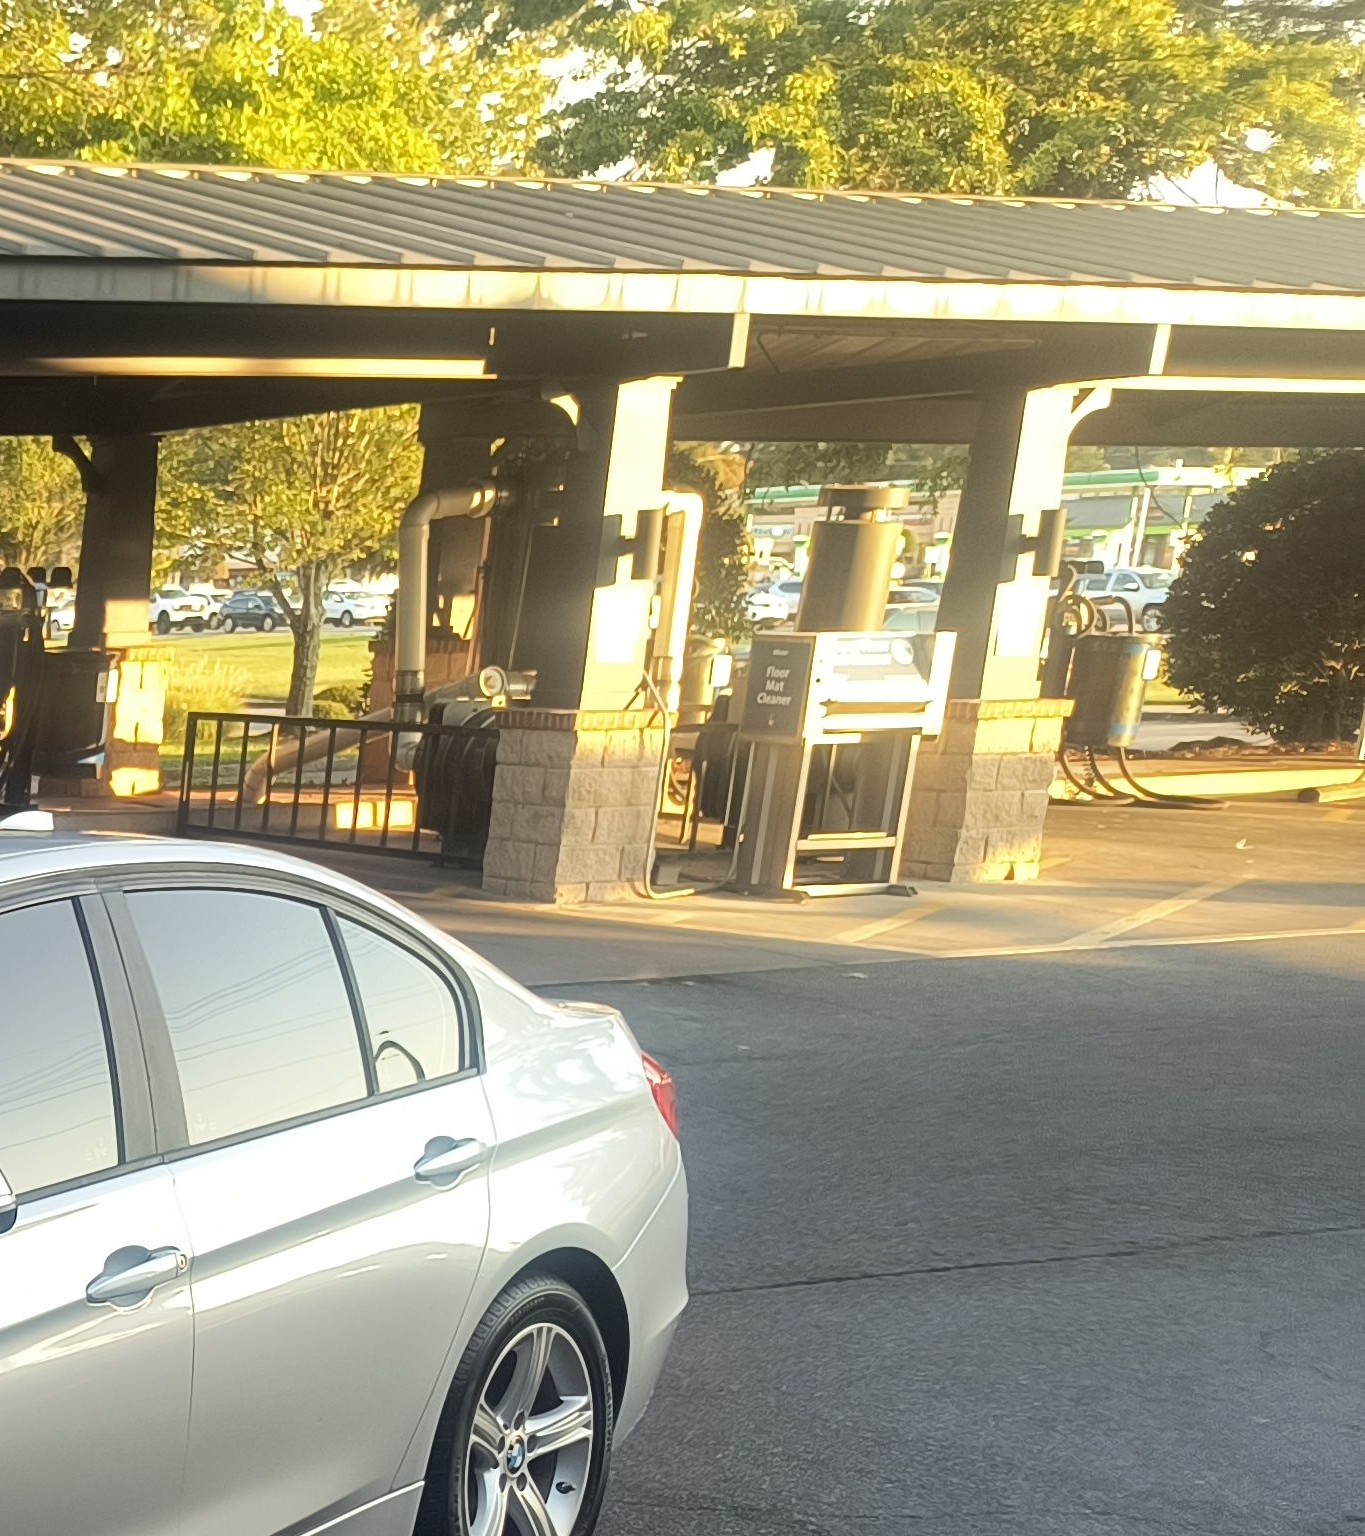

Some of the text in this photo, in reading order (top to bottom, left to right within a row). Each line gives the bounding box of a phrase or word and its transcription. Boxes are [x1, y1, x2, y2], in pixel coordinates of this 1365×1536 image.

[766, 666, 791, 678] Floor
[765, 681, 785, 692] Mat
[757, 693, 792, 706] Cleaner
